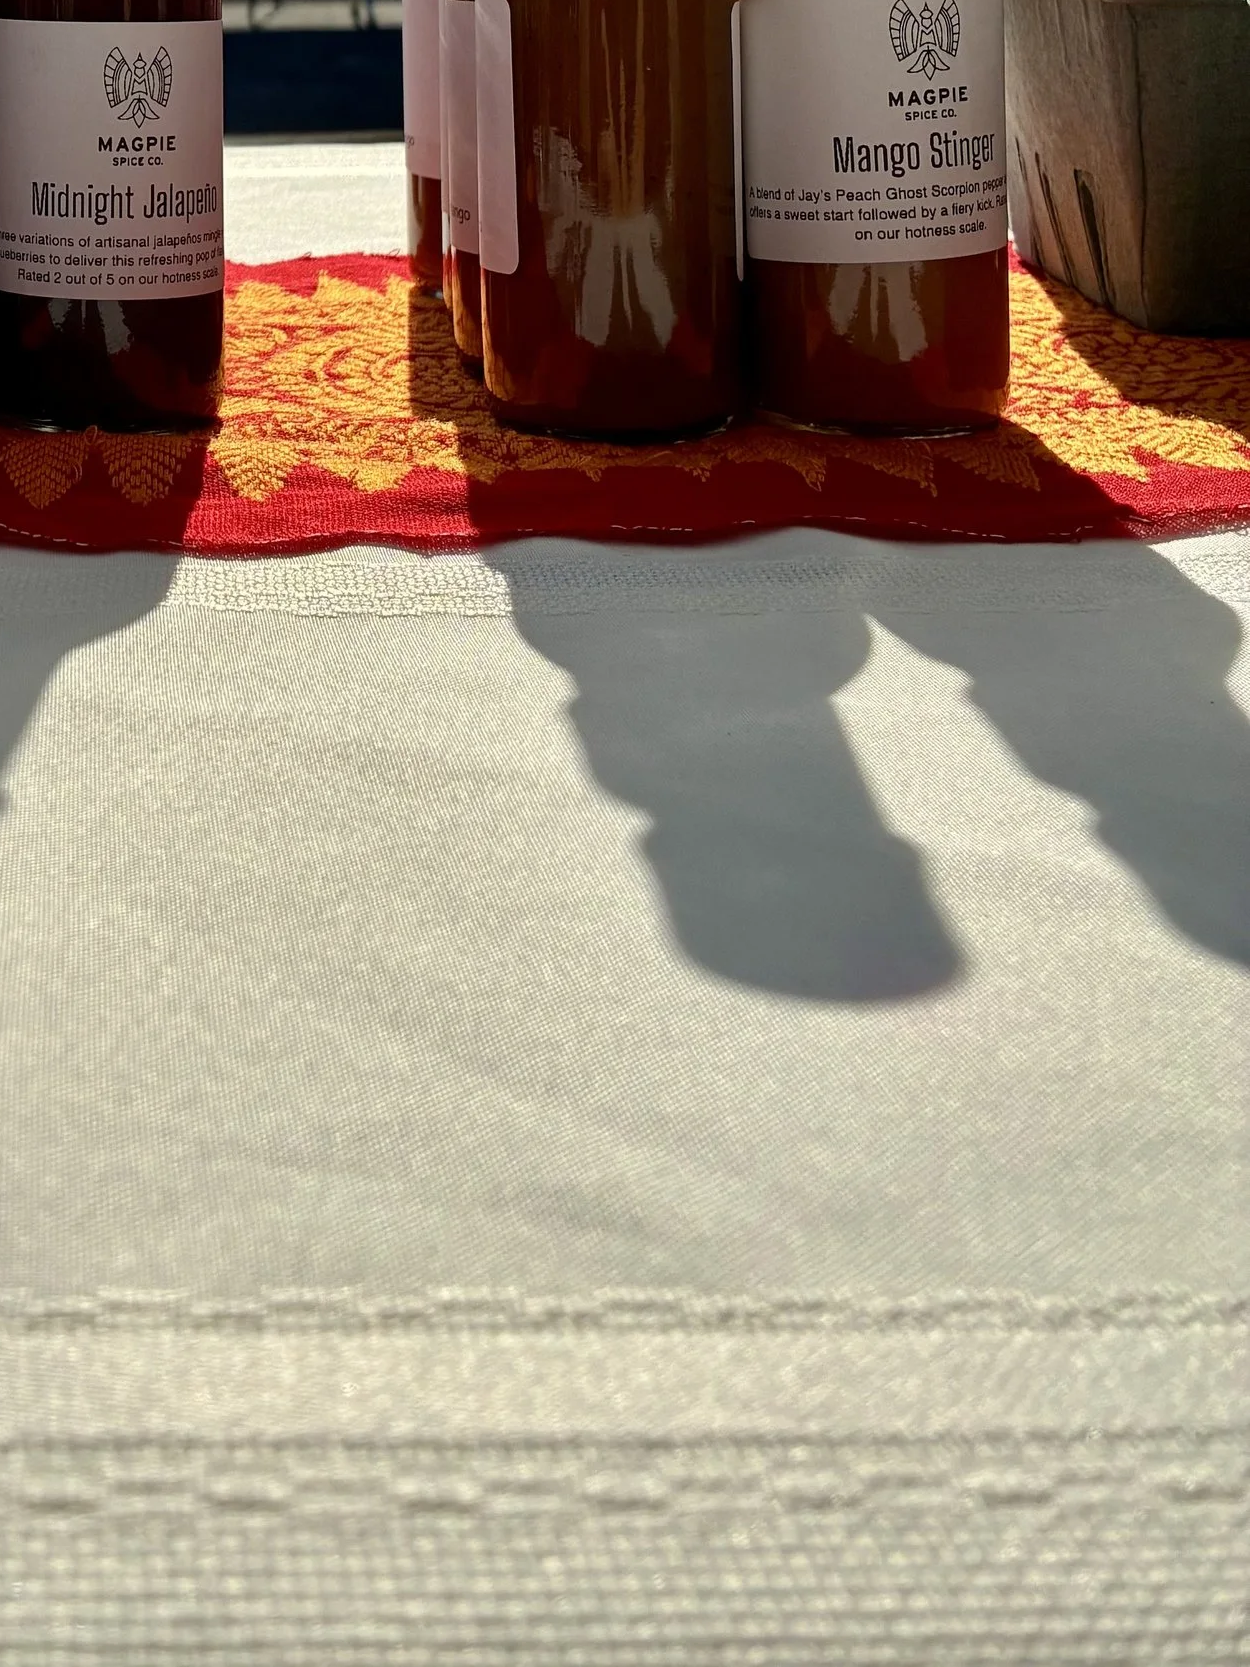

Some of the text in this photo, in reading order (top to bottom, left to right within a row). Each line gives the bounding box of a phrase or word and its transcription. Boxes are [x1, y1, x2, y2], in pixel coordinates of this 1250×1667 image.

[888, 86, 968, 107] MAGPIE
[905, 108, 957, 121] SPICE CO.
[98, 135, 176, 152] MAGPIE
[112, 156, 163, 166] SPICE CO.
[833, 130, 995, 178] Mango Stinger
[756, 187, 781, 200] blend
[784, 188, 795, 201] of
[798, 189, 831, 204] Jay's
[836, 188, 881, 201] Peach
[886, 186, 927, 200] Ghost
[931, 181, 980, 197] Scorpion
[32, 181, 217, 225] Midnight Jalapeño
[774, 210, 781, 220] a
[784, 209, 820, 221] sweet
[823, 209, 854, 221] start
[858, 206, 916, 221] followed
[921, 206, 937, 220] by
[940, 206, 948, 216] a
[952, 202, 974, 216] fiery
[855, 219, 987, 240] on our hotness scale.
[19, 233, 74, 247] variations
[78, 236, 91, 247] of
[94, 236, 150, 248] artisanal
[153, 233, 202, 250] jalapeños
[49, 253, 61, 265] to
[64, 254, 108, 266] deliver
[112, 254, 134, 266] this
[138, 252, 193, 266] refreshing
[196, 251, 209, 264] pop
[17, 268, 50, 282] Rated
[54, 272, 61, 284] 2
[65, 273, 86, 285] out
[89, 273, 102, 285] of
[106, 273, 114, 285] 5
[118, 275, 135, 285] on
[139, 275, 158, 284] our
[162, 270, 200, 284] hotness
